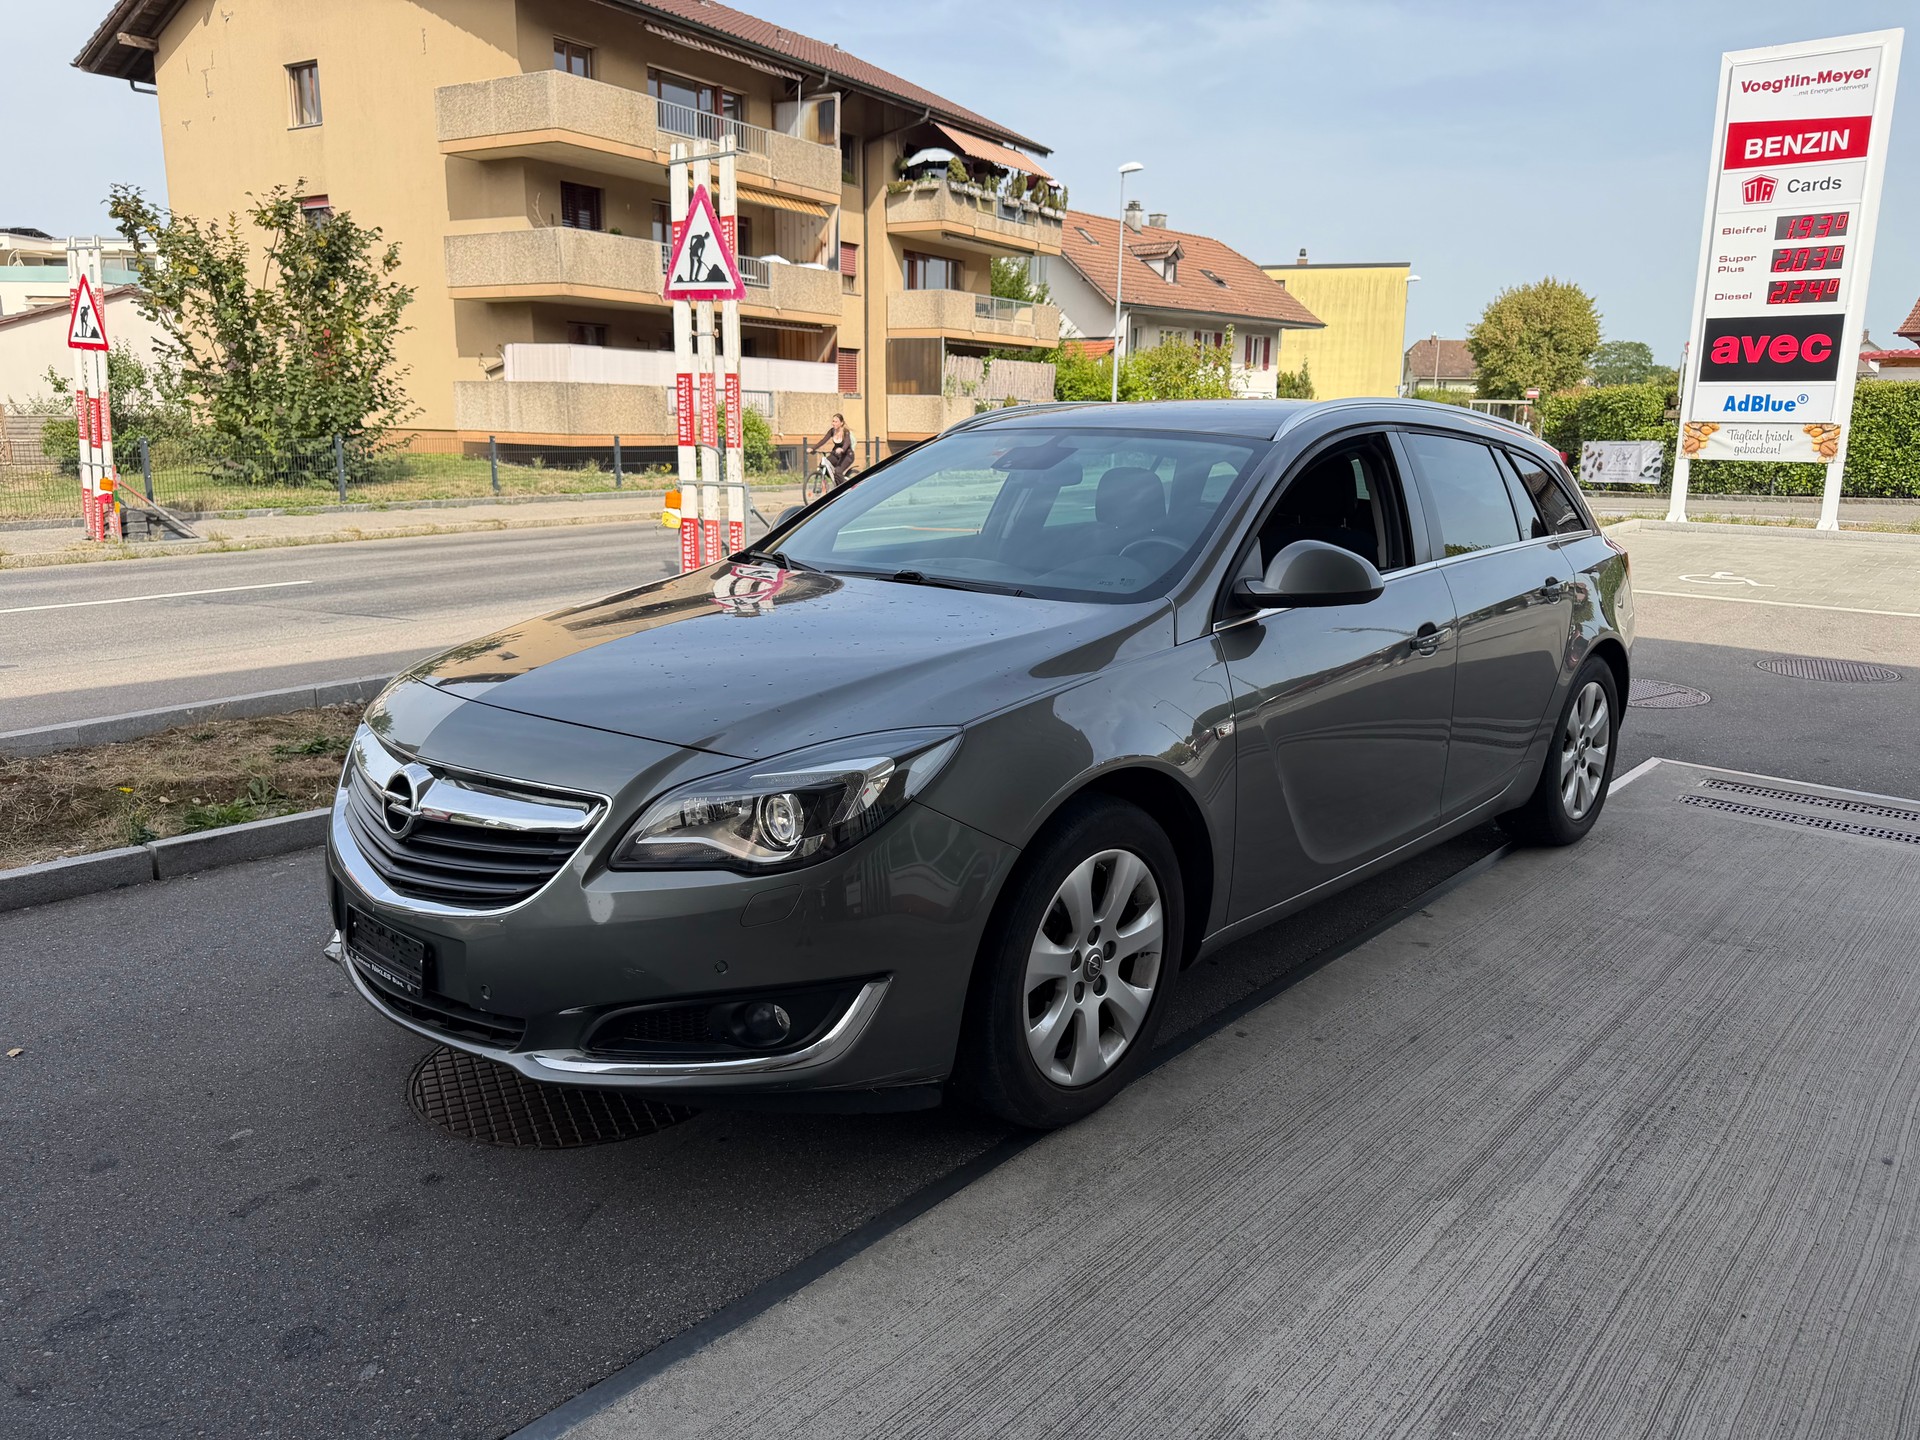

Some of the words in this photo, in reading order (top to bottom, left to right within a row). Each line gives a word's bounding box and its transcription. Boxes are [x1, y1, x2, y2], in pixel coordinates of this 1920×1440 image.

[1741, 68, 1871, 93] Voegtlin-Meyer
[1810, 87, 1834, 95] Energie
[1835, 83, 1869, 92] unterwegs
[1744, 129, 1850, 159] BENZIN
[1744, 177, 1776, 203] UTA
[1787, 176, 1842, 193] Cards
[1722, 225, 1767, 235] Bleifrei
[1718, 265, 1745, 273] Plus
[1719, 255, 1757, 264] Super
[1714, 292, 1752, 300] Diesel
[1711, 333, 1832, 364] avec
[678, 377, 687, 441] IMPERIALI
[701, 378, 710, 442] IMPERIALI
[726, 378, 735, 443] IMPERIALI
[1727, 429, 1763, 443] Täglich
[1765, 429, 1794, 443] frisch
[1734, 443, 1781, 456] gebacken!
[683, 521, 692, 572] PERIALI
[706, 524, 714, 562] ERIALI
